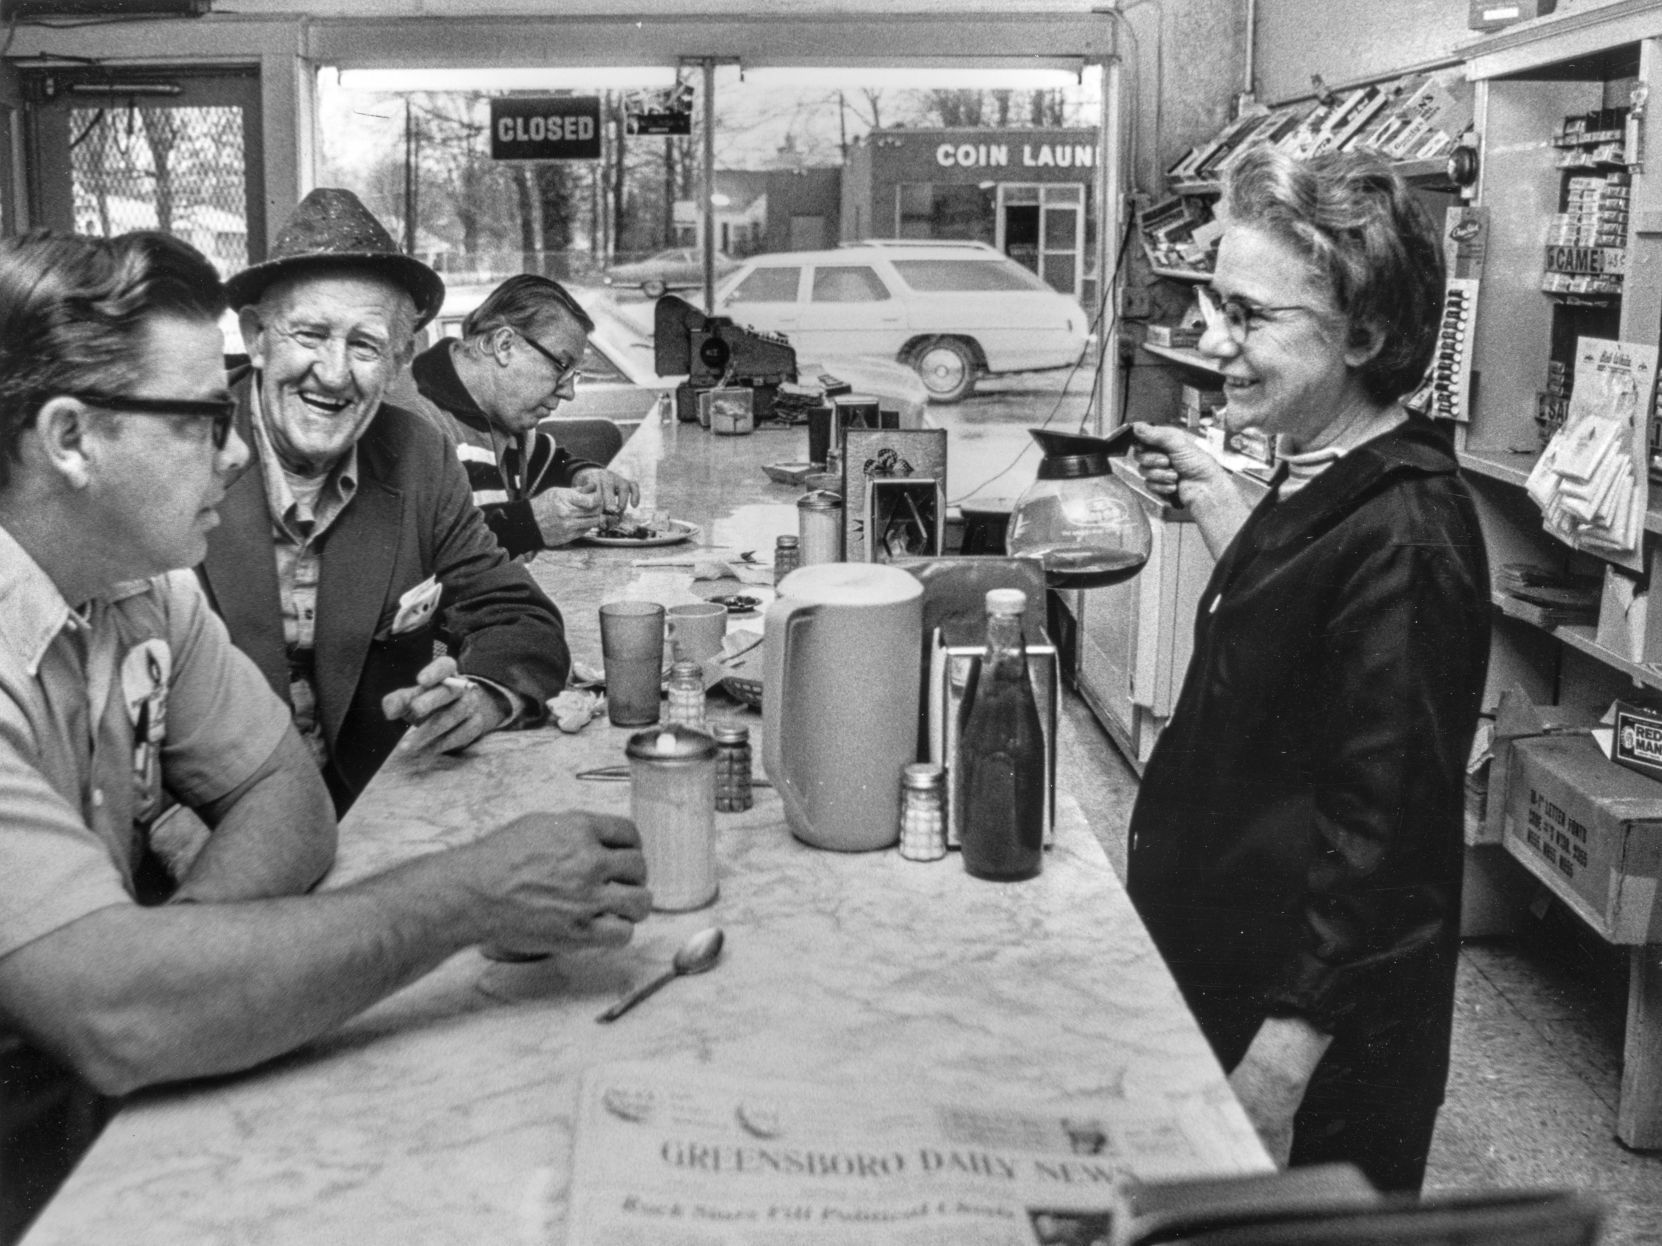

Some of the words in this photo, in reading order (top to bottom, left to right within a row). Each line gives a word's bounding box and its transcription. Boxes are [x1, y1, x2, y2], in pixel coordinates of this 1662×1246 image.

[498, 115, 595, 142] CLOSED
[936, 143, 1008, 167] COIN
[1023, 143, 1100, 168] LAUN
[1636, 726, 1662, 742] RED
[1636, 738, 1662, 755] MAN
[660, 1140, 905, 1178] GREENSBORO
[919, 1149, 1015, 1179] DAILY
